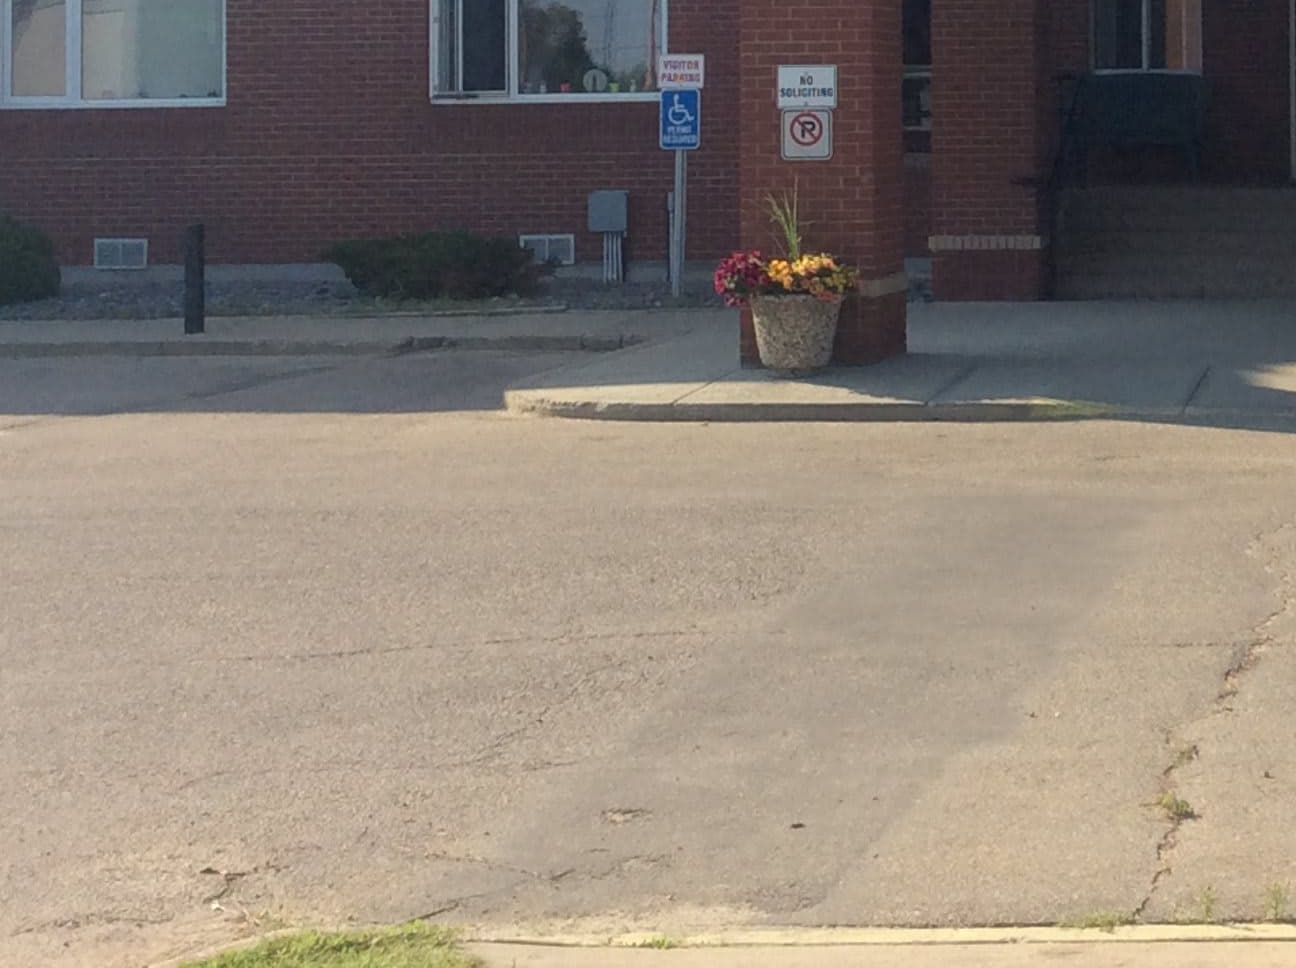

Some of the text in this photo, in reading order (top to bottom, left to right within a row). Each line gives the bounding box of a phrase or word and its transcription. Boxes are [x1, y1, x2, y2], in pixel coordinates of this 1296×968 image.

[663, 60, 699, 70] VISITOR
[661, 73, 701, 82] PARKING
[800, 75, 813, 85] NO
[780, 87, 833, 98] SOLICITING
